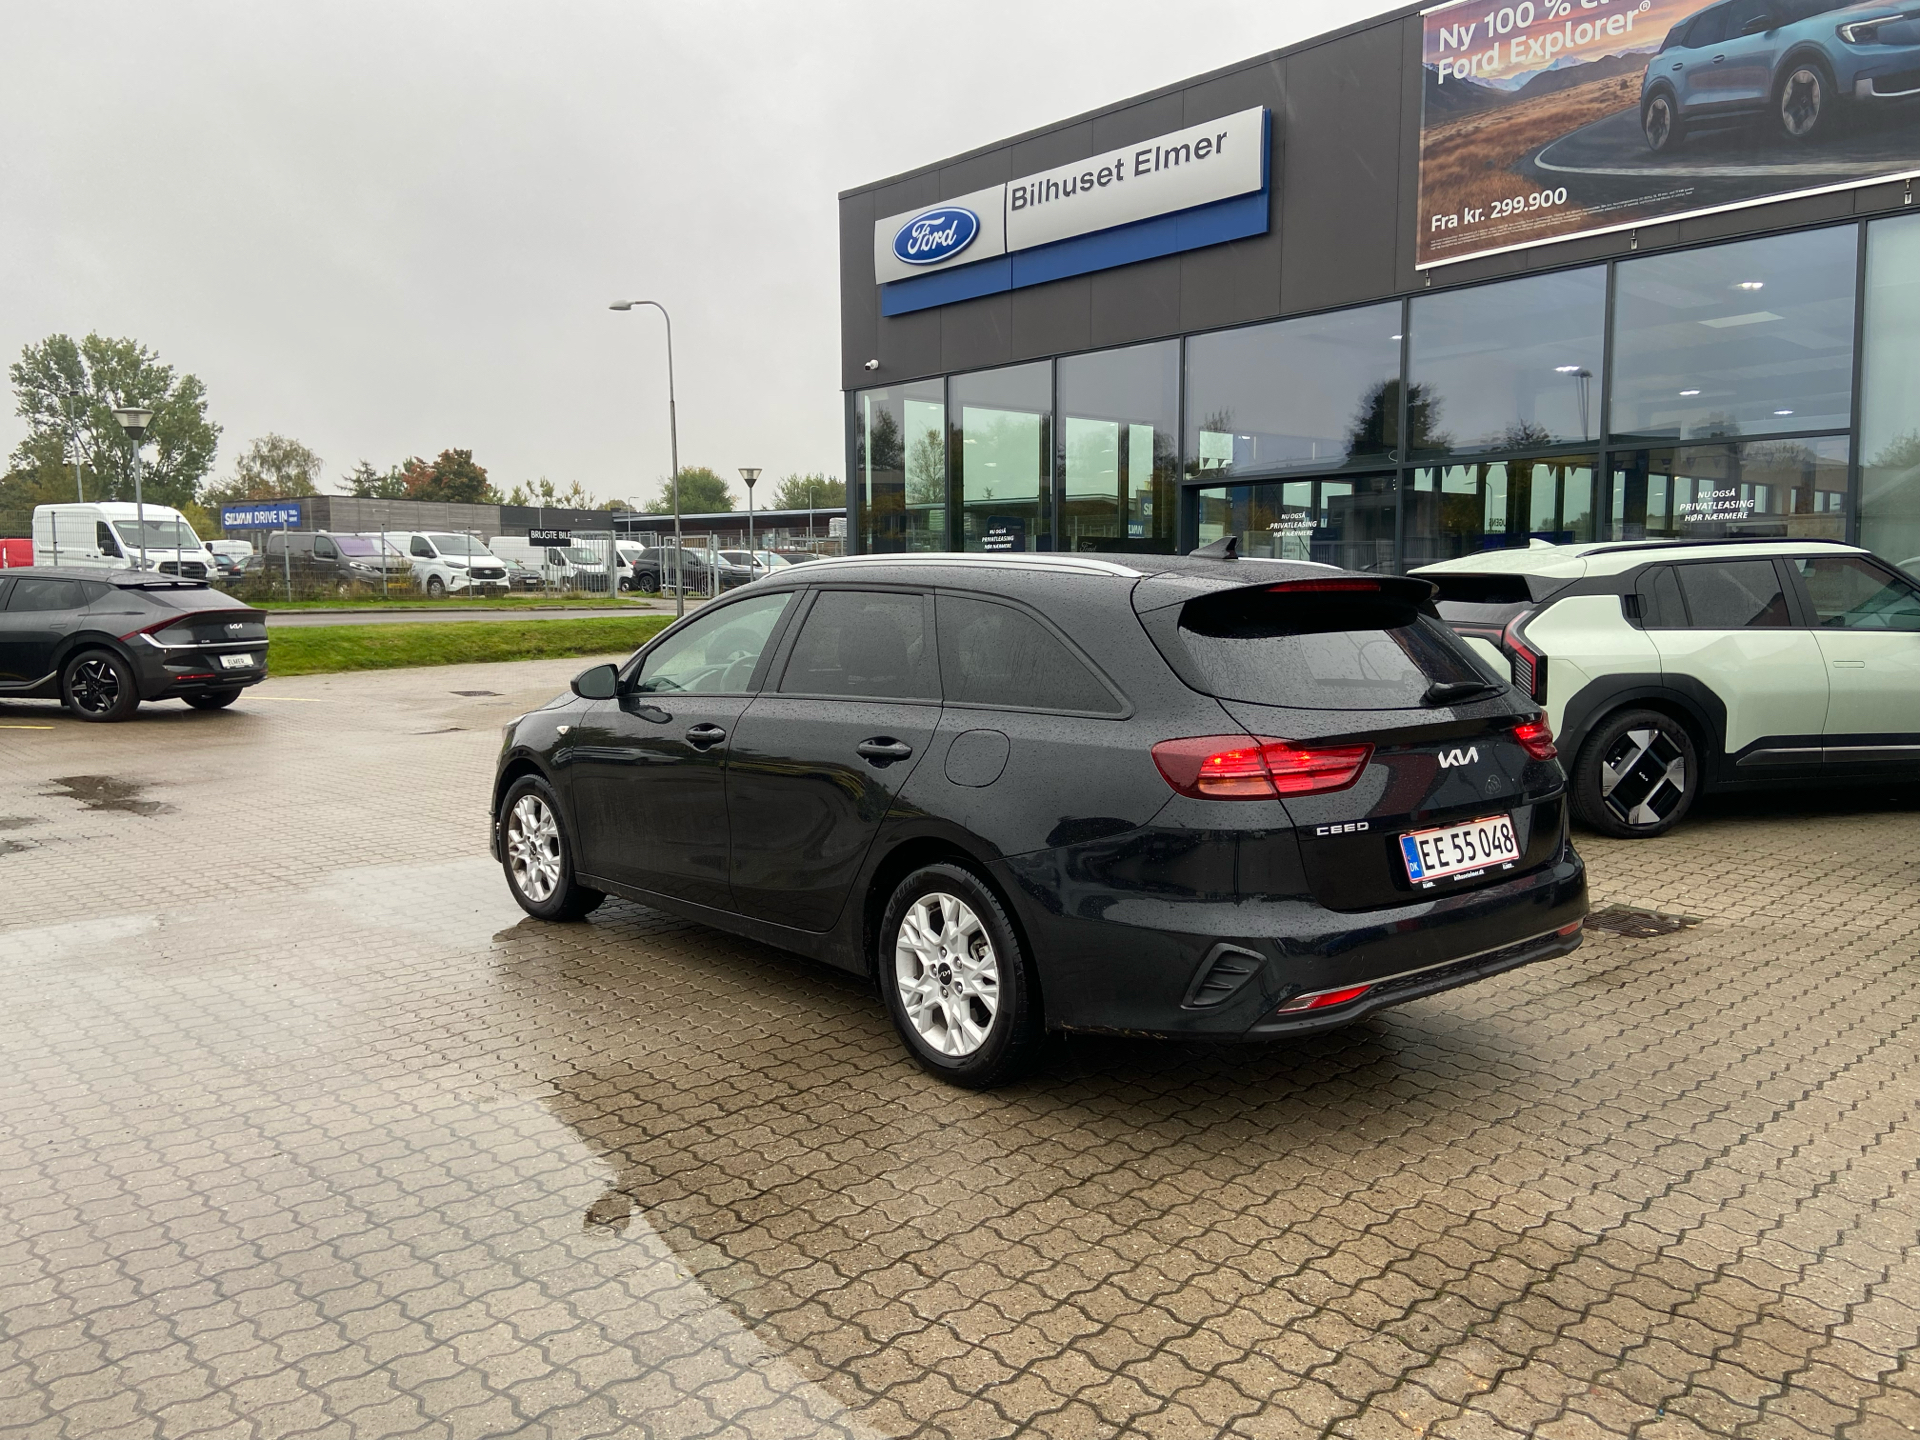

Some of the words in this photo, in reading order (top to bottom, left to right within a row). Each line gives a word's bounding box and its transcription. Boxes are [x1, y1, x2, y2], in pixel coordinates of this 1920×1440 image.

[1439, 23, 1476, 52] Ny
[1484, 0, 1535, 37] 100
[1545, 0, 1571, 19] %
[1438, 42, 1499, 85] Ford
[1011, 158, 1125, 211] Bilhuset
[1134, 131, 1228, 177] Elmer
[1431, 213, 1458, 232] Fra
[1463, 207, 1486, 225] kr.
[1490, 187, 1568, 219] 299.900
[907, 216, 958, 255] Ford
[1697, 491, 1711, 499] NU
[1712, 488, 1736, 498] OGSÅ
[1680, 500, 1754, 511] PRIVATLEASING
[225, 512, 252, 525] SILVAN
[254, 511, 277, 523] DRIVE
[279, 510, 288, 522] IN
[1291, 511, 1306, 519] OGSÅ
[1684, 514, 1703, 522] HØR
[1704, 512, 1748, 520] NÆRMERE
[1269, 521, 1317, 529] PRIVATLEASING
[531, 531, 557, 539] BRUGTE
[1438, 746, 1479, 769] KIA
[1316, 822, 1369, 836] CEED
[1419, 837, 1450, 870] EE
[1450, 830, 1476, 864] 55
[1478, 823, 1514, 858] 048
[1409, 861, 1419, 872] DK
